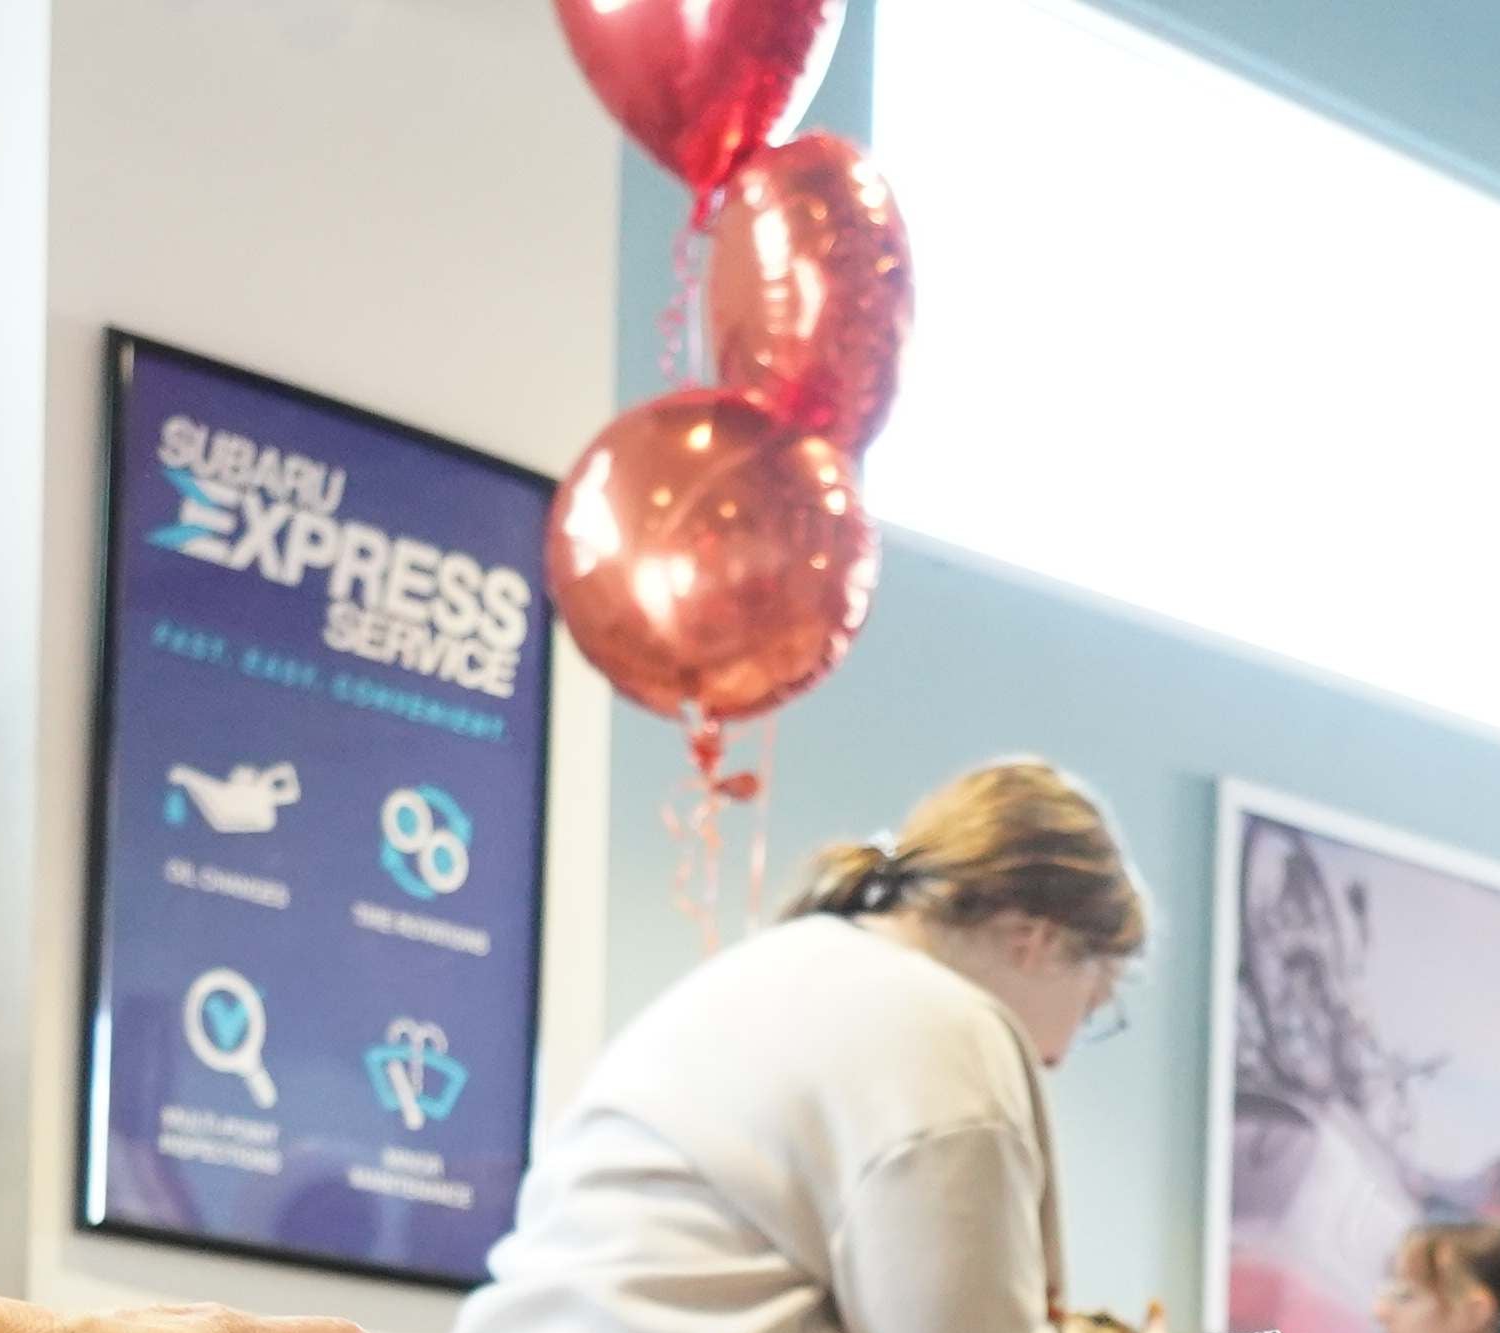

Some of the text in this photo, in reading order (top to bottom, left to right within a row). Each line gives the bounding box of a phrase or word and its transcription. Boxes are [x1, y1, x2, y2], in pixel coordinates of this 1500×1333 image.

[159, 414, 348, 516] SUBARU
[147, 467, 532, 650] EXPRESS
[322, 601, 521, 699] SERVICE
